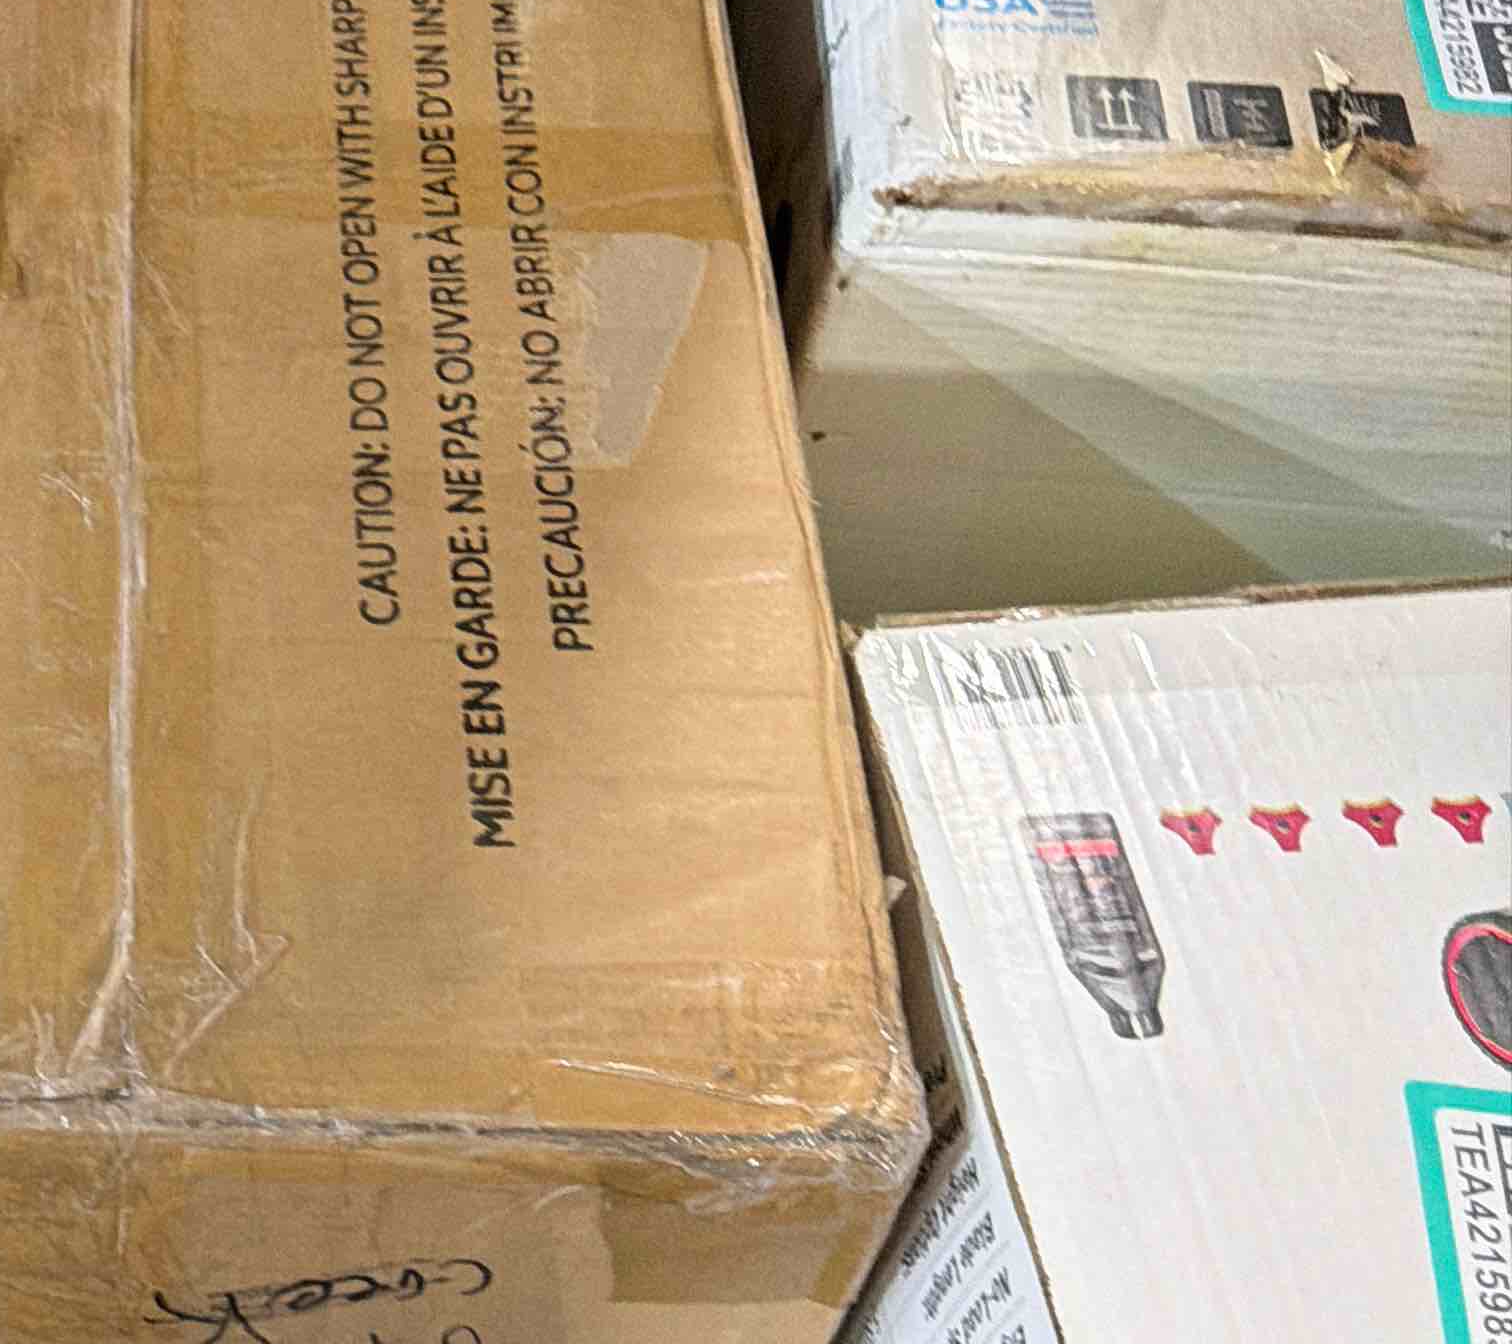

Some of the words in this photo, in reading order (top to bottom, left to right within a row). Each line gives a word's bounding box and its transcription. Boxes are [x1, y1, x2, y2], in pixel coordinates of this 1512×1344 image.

[413, 43, 454, 119] D'UN
[335, 104, 375, 190] WITH
[417, 125, 461, 218] L'AIDE
[503, 144, 546, 216] CON
[339, 196, 379, 286] OPEN
[510, 223, 558, 322] ABRIR
[344, 293, 384, 368] NOT
[428, 254, 475, 385] OUVRIR
[521, 330, 564, 384] NO
[349, 377, 389, 432] DO
[439, 392, 482, 460] PAS
[443, 468, 485, 514] NE
[352, 443, 400, 626] CAUTION:
[448, 525, 500, 670] GARDE:
[460, 679, 506, 736] EN
[467, 746, 516, 848] MISE
